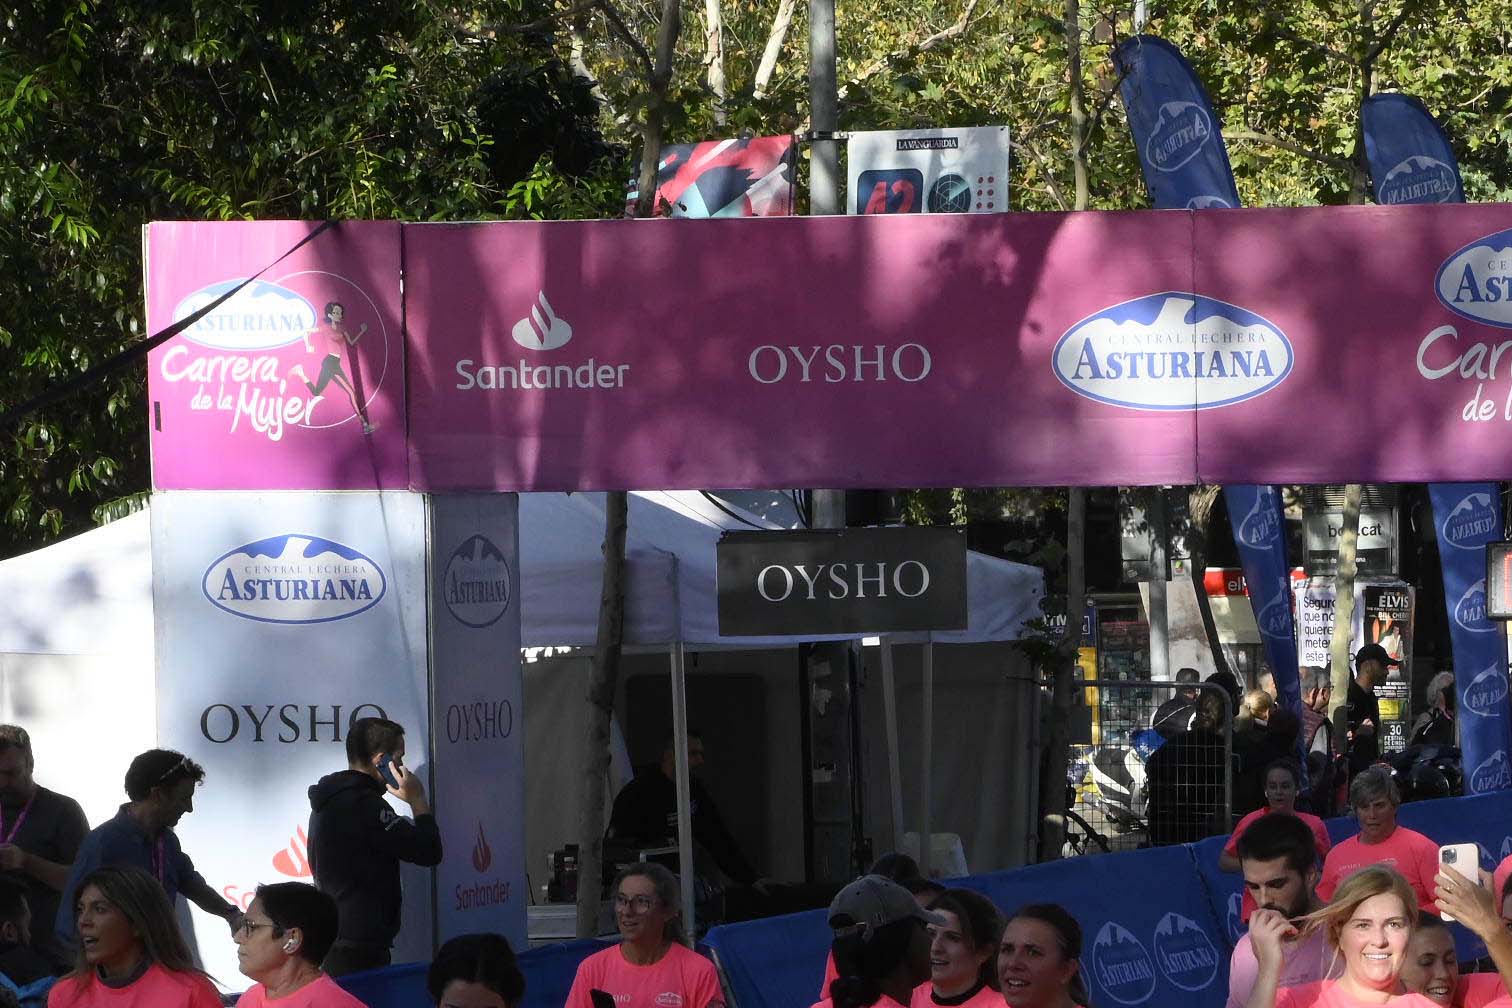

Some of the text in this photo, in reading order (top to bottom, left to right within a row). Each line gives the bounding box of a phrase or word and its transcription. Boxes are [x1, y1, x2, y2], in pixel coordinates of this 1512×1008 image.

[1108, 331, 1266, 346] CENTRAL LECHERA
[161, 345, 279, 382] Carrera
[456, 358, 630, 390] Santander
[748, 343, 932, 384] OYSHO
[1073, 334, 1274, 380] ASTURIANA
[190, 380, 326, 442] de la Mujer
[1462, 381, 1496, 423] de
[217, 567, 373, 601] ASTURIANA
[245, 564, 366, 574] CENTRAL LECHERA
[757, 560, 931, 602] OYSHO
[1378, 596, 1409, 608] ELVIS
[446, 699, 513, 744] OYSHO
[1390, 724, 1402, 736] 30
[455, 880, 512, 912] Santander
